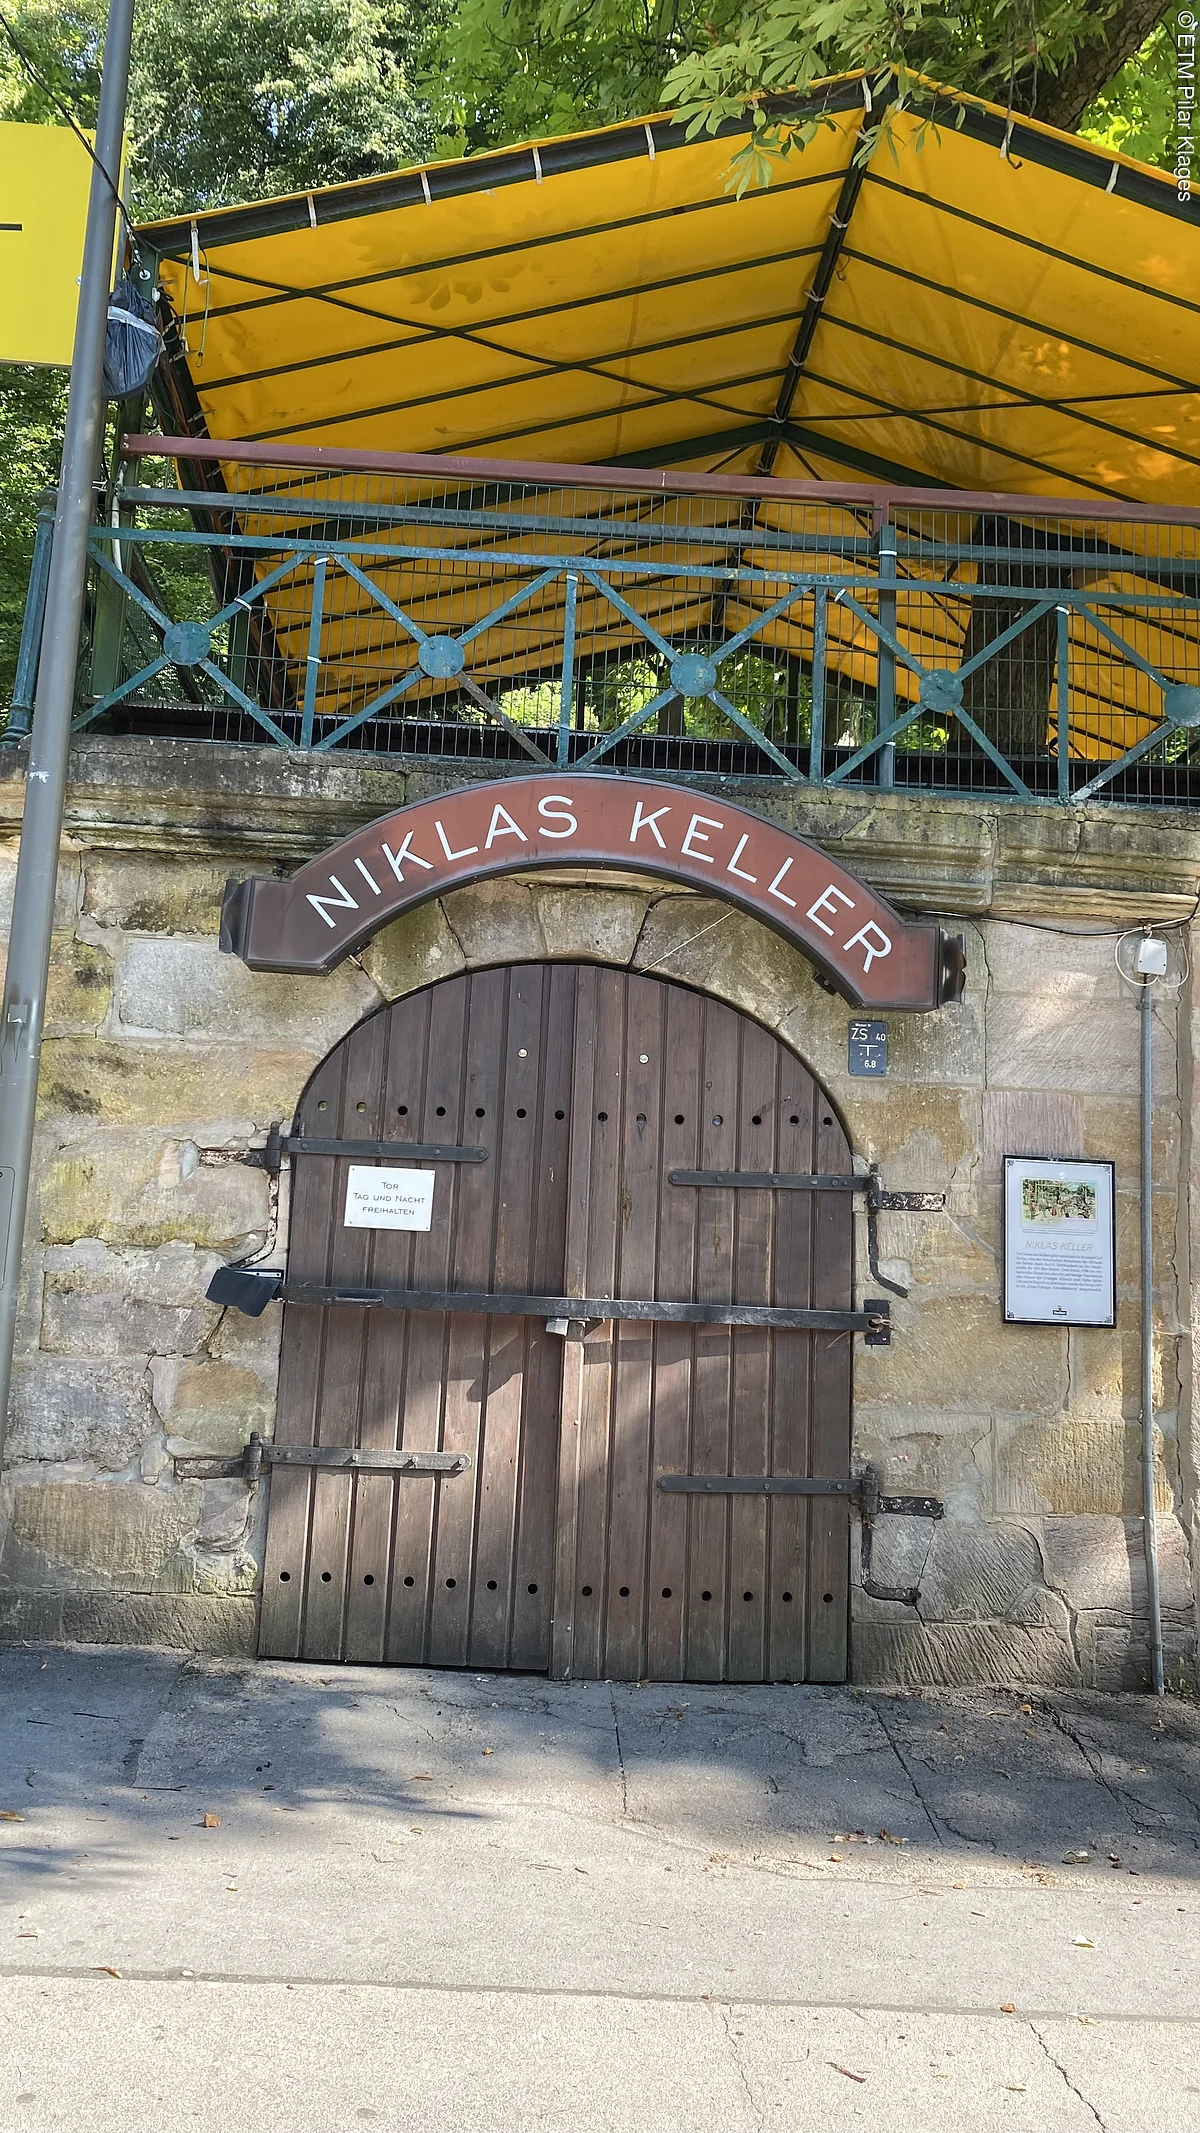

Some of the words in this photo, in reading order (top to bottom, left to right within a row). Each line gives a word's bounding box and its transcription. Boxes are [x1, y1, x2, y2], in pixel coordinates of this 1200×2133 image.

[305, 794, 579, 929] NIKLAS
[629, 800, 893, 973] KELLER
[851, 1027, 868, 1040] ZS
[875, 1033, 886, 1042] 40
[864, 1059, 877, 1069] 6.8
[381, 1181, 399, 1190] TOR
[353, 1192, 369, 1201] TAG
[395, 1195, 426, 1204] NACHT
[362, 1206, 415, 1216] FREIHALTEN
[1025, 1240, 1059, 1250] NIKLAS
[1060, 1242, 1094, 1252] KELLER
